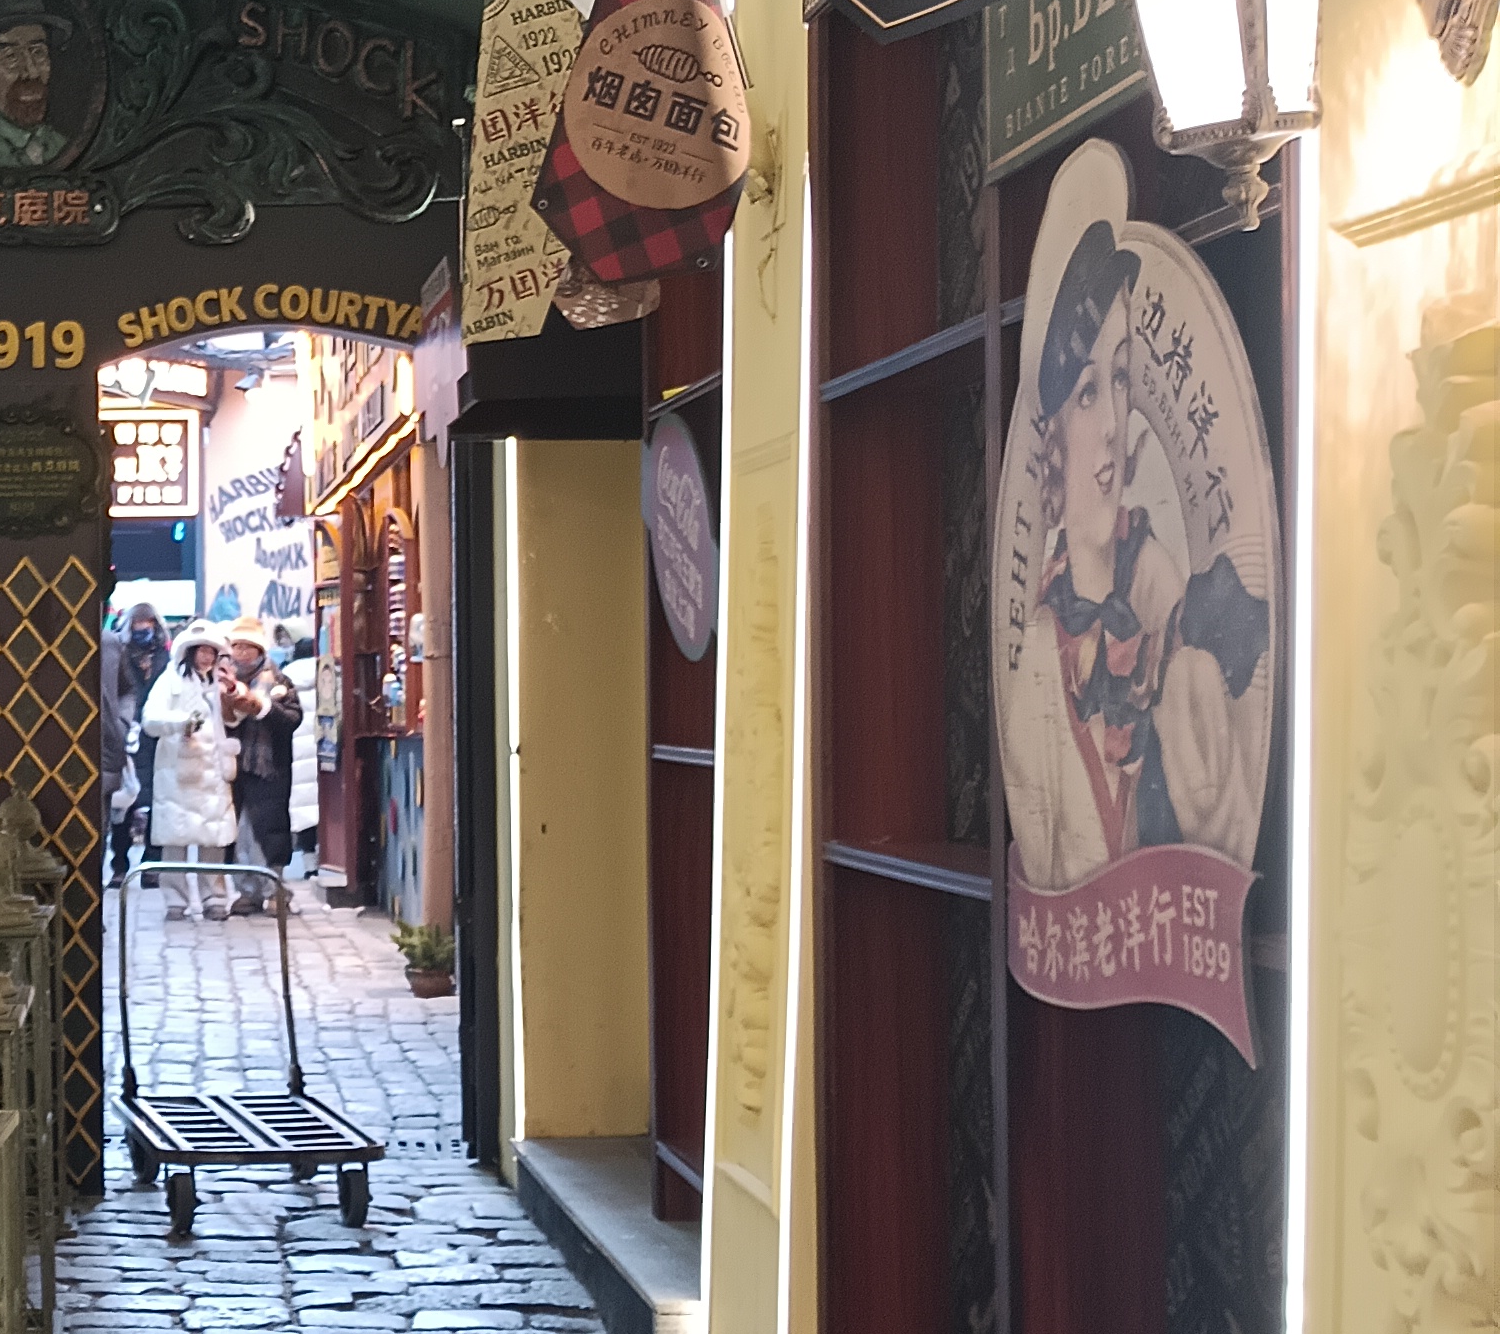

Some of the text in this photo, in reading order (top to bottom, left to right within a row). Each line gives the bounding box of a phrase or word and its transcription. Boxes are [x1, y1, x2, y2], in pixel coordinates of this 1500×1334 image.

[522, 26, 558, 51] 1922
[600, 8, 709, 56] CHIMNEY
[238, 0, 442, 120] SHOCK
[581, 65, 740, 153] 烟囱面包
[483, 137, 547, 169] HARBIN
[117, 285, 248, 349] SHOCK
[1181, 884, 1218, 930] EST
[1182, 933, 1232, 983] 1899
